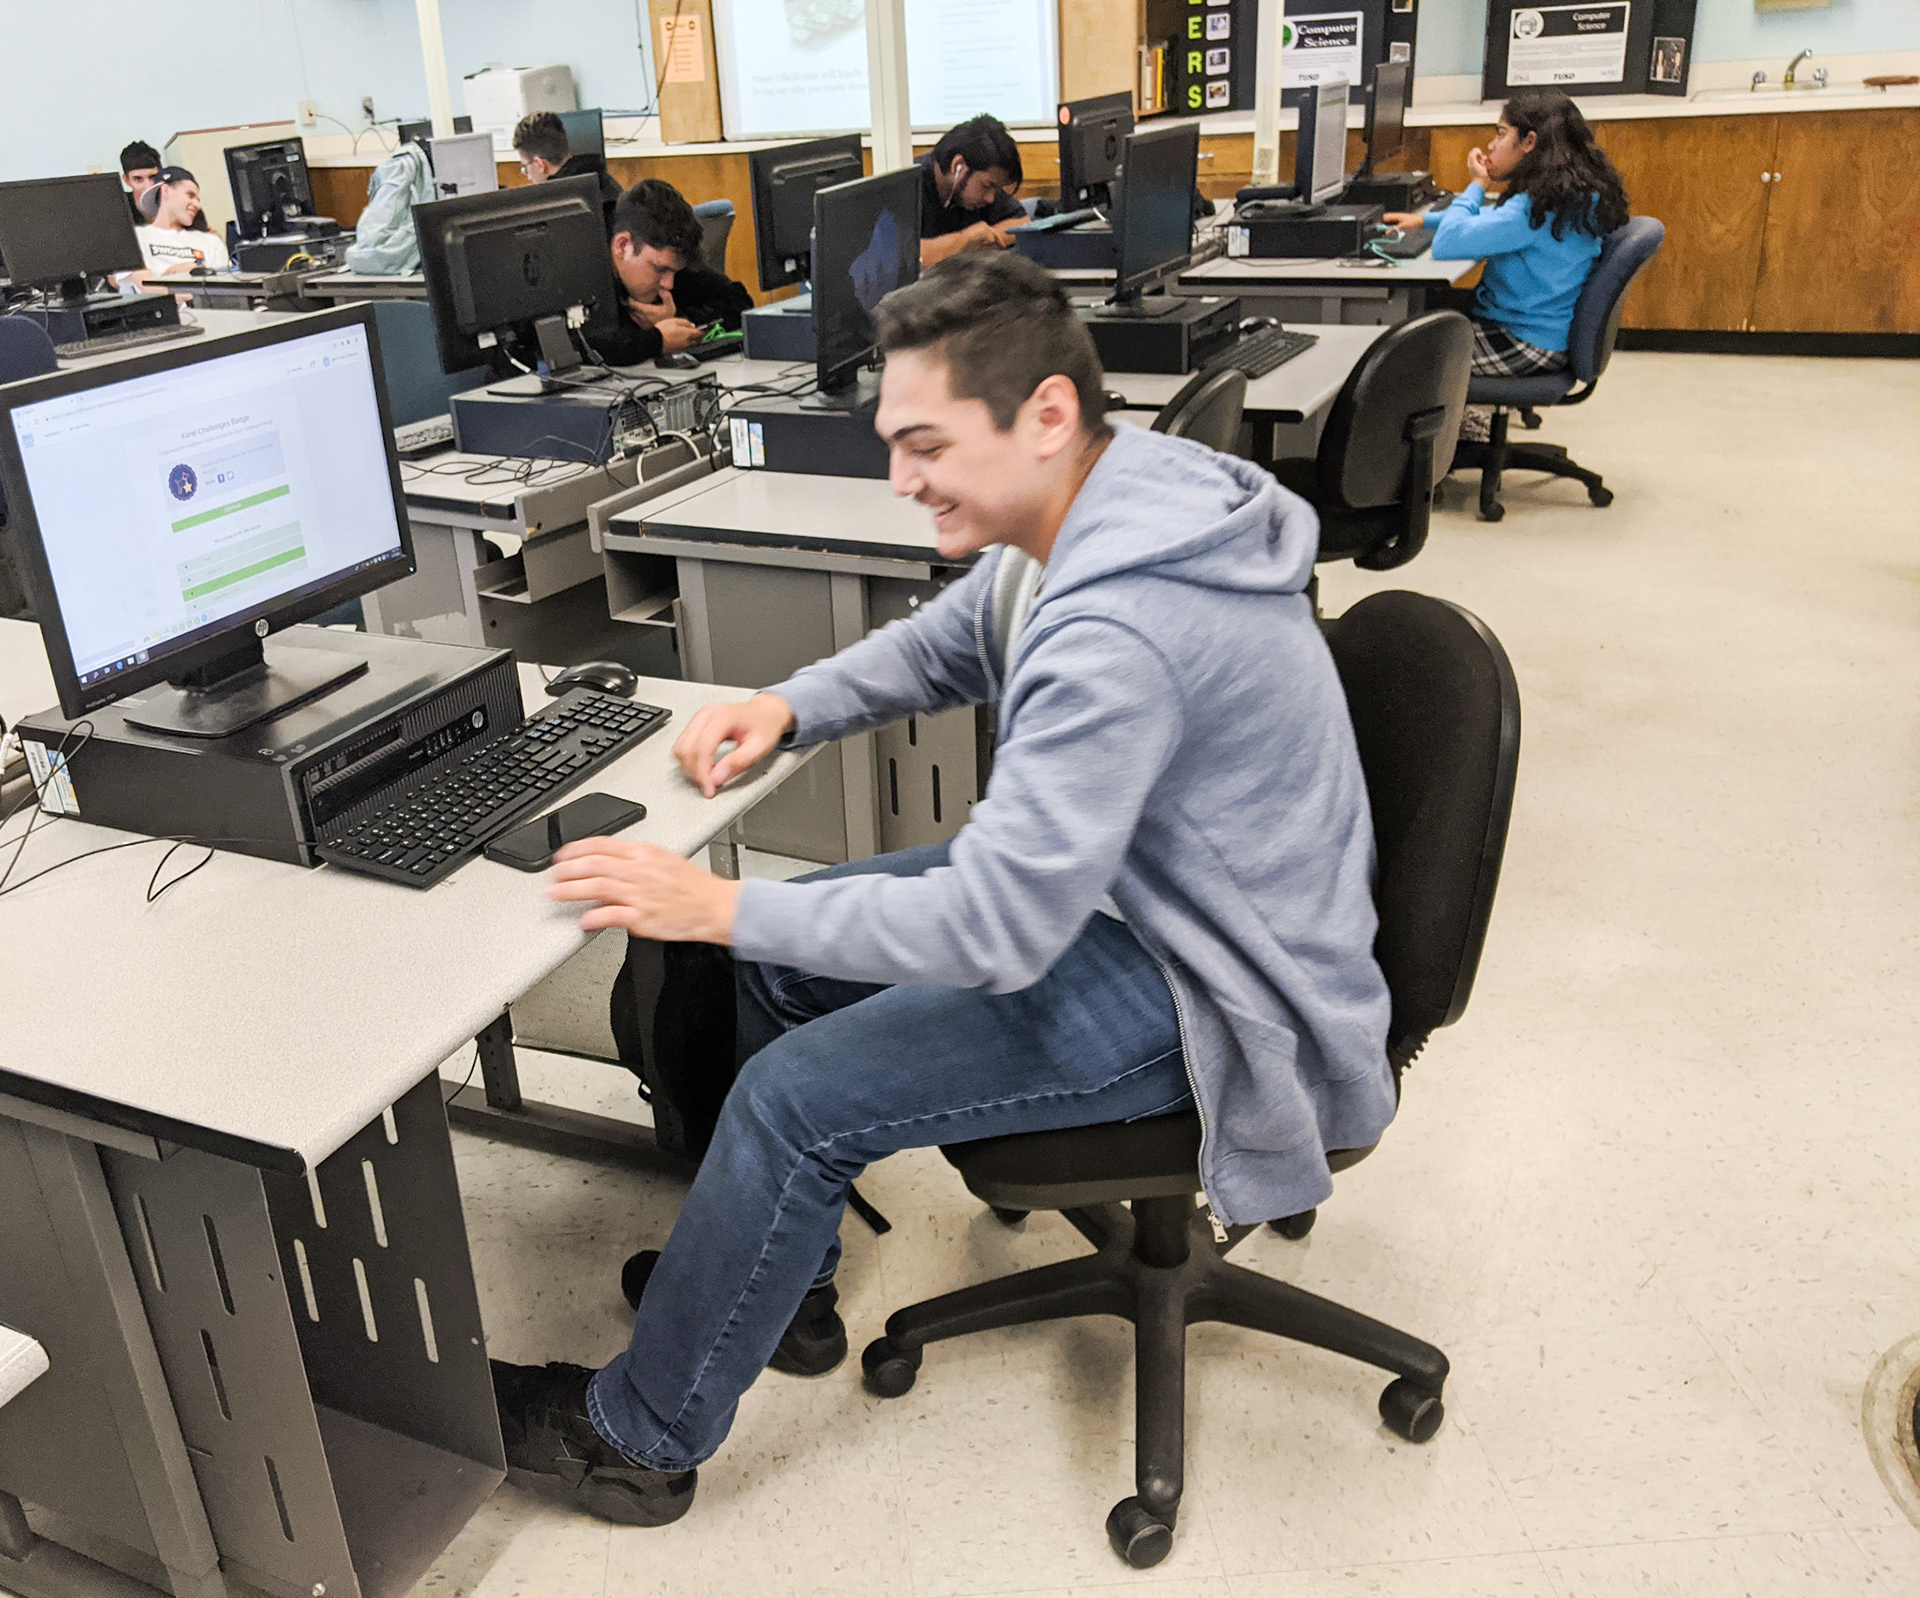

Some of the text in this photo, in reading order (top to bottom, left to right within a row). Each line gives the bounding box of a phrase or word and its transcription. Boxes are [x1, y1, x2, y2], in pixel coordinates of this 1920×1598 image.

[1572, 11, 1612, 22] Computer
[1298, 23, 1358, 36] Computer
[1577, 22, 1607, 31] Science
[1304, 36, 1350, 48] Science
[1187, 0, 1203, 108] ERS
[198, 420, 231, 435] Challenges
[231, 415, 250, 426] Badge
